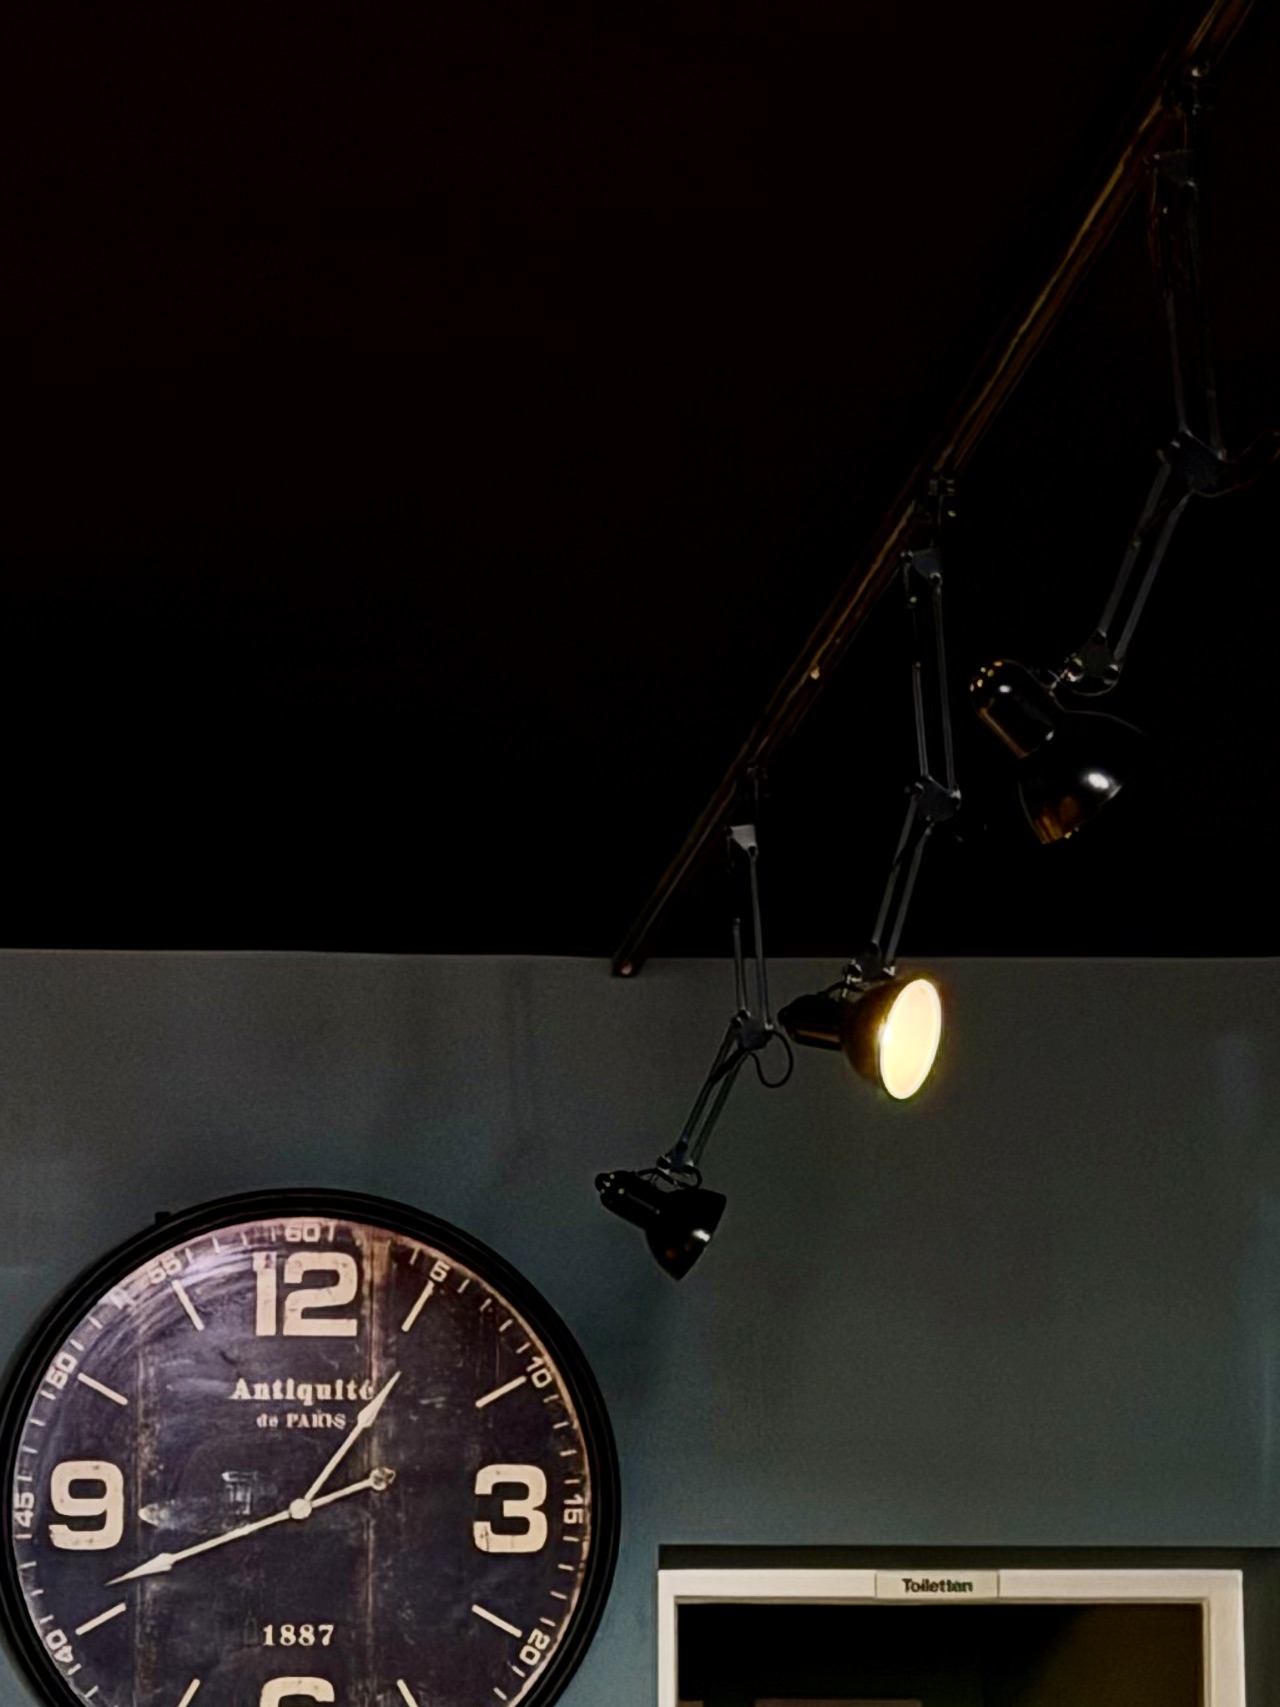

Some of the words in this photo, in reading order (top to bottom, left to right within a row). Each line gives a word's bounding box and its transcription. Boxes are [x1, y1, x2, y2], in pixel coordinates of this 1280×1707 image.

[284, 1223, 320, 1242] 60
[253, 1251, 358, 1337] 12
[526, 1357, 553, 1388] 10
[256, 1413, 278, 1428] de
[286, 1412, 347, 1430] PARIS
[14, 1492, 34, 1527] 45
[49, 1460, 124, 1551] 9
[473, 1464, 548, 1553] 3
[563, 1494, 583, 1524] 15
[901, 1578, 973, 1593] Toiletten
[45, 1629, 74, 1663] 40
[263, 1624, 334, 1646] 1887
[519, 1629, 551, 1666] 20
